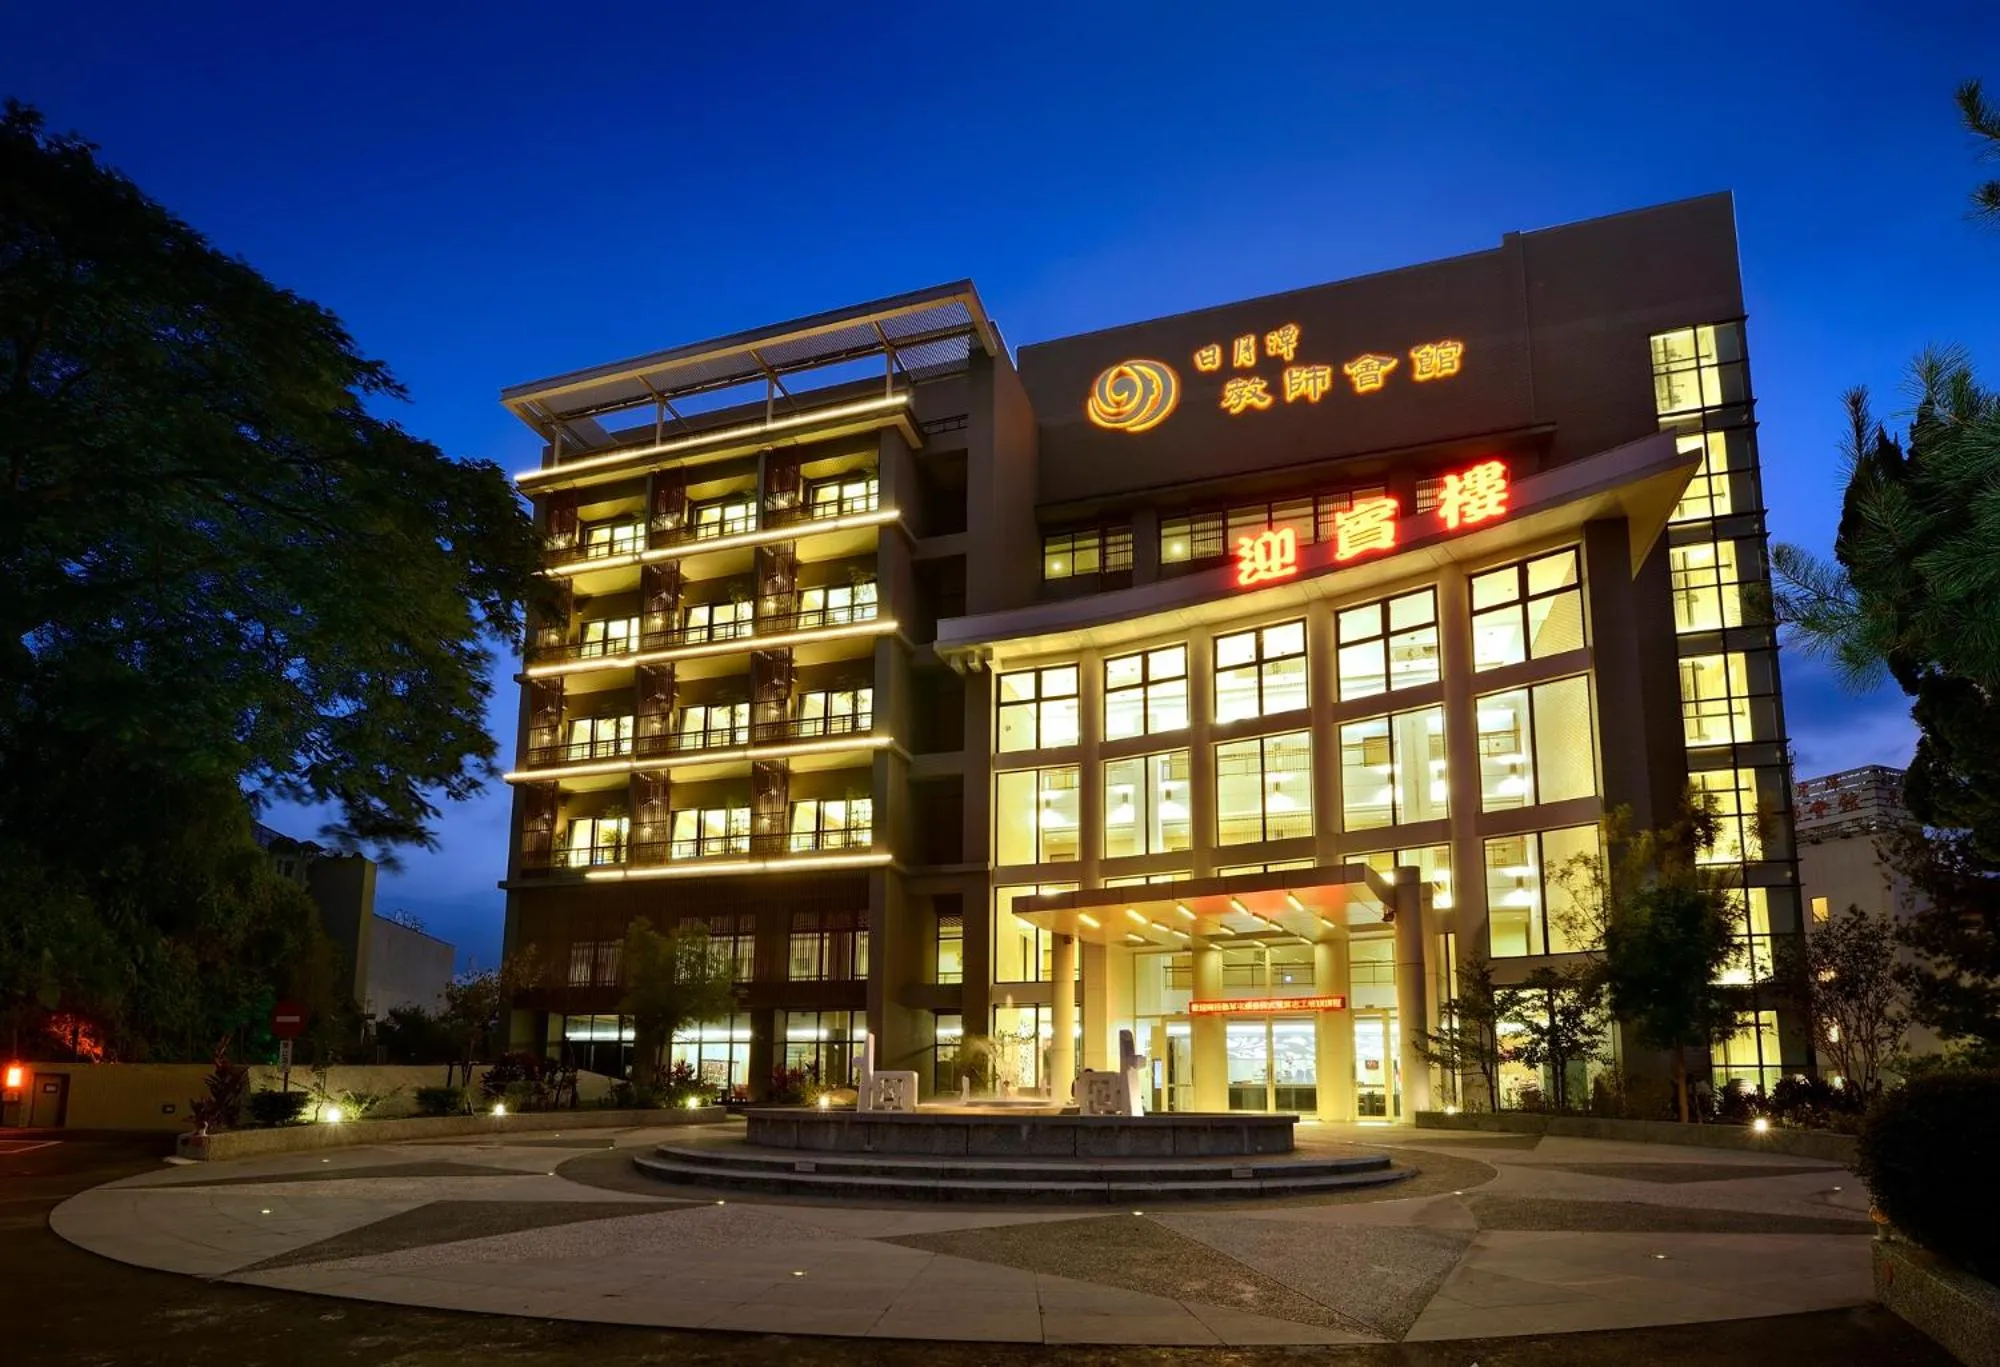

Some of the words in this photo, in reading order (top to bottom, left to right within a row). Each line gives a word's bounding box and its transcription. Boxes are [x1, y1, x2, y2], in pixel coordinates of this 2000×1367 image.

[1221, 341, 1464, 414] 教師會館
[1237, 460, 1509, 586] 迎賓樓
